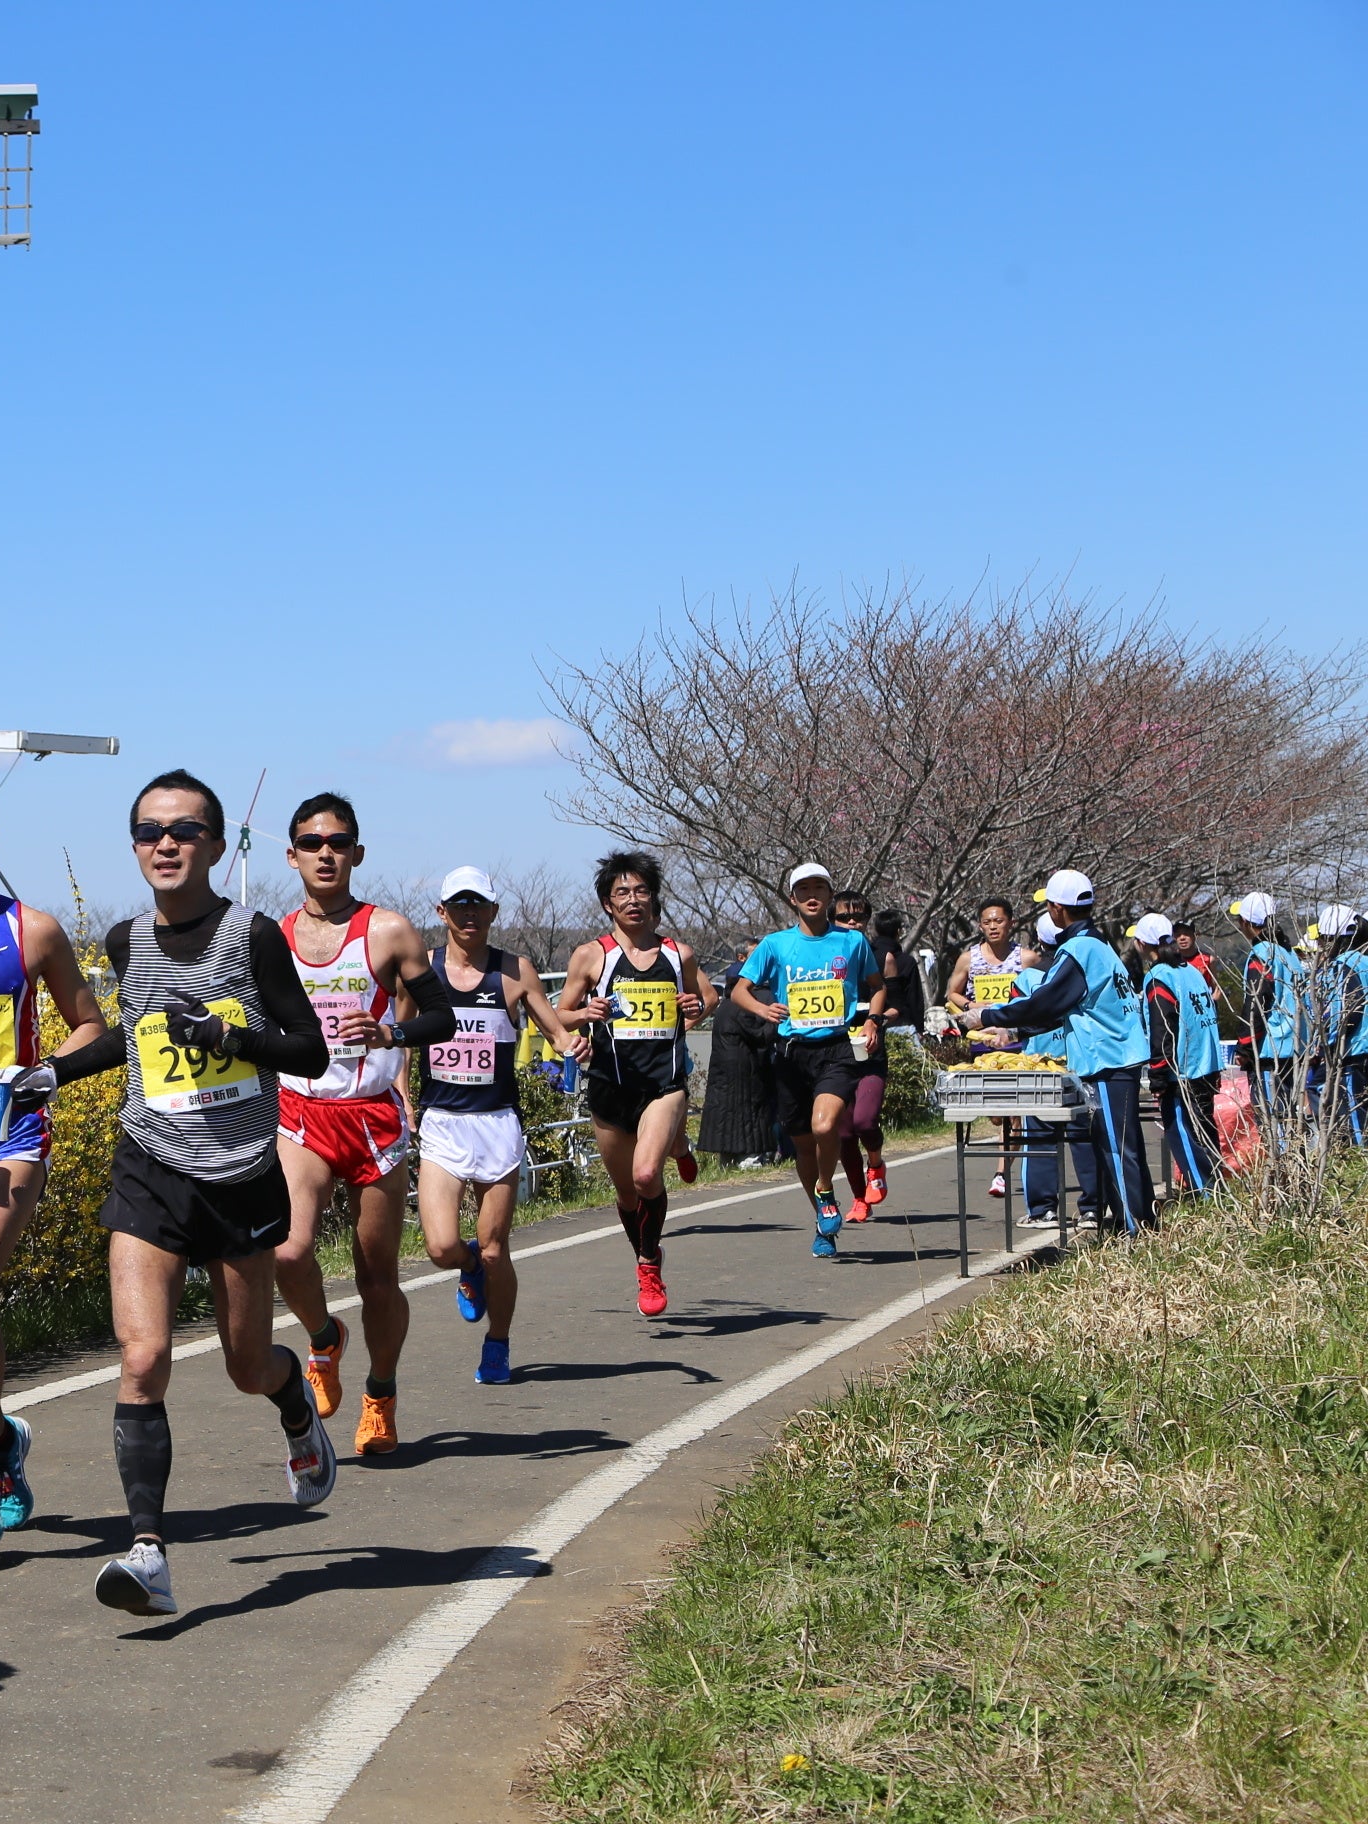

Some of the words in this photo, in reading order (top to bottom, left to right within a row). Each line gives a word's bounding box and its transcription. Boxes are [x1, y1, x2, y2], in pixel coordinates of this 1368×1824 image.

[625, 1001, 665, 1021] 251
[798, 995, 835, 1015] 250
[432, 1047, 492, 1070] 2918
[188, 1086, 240, 1106] 朝日新聞
